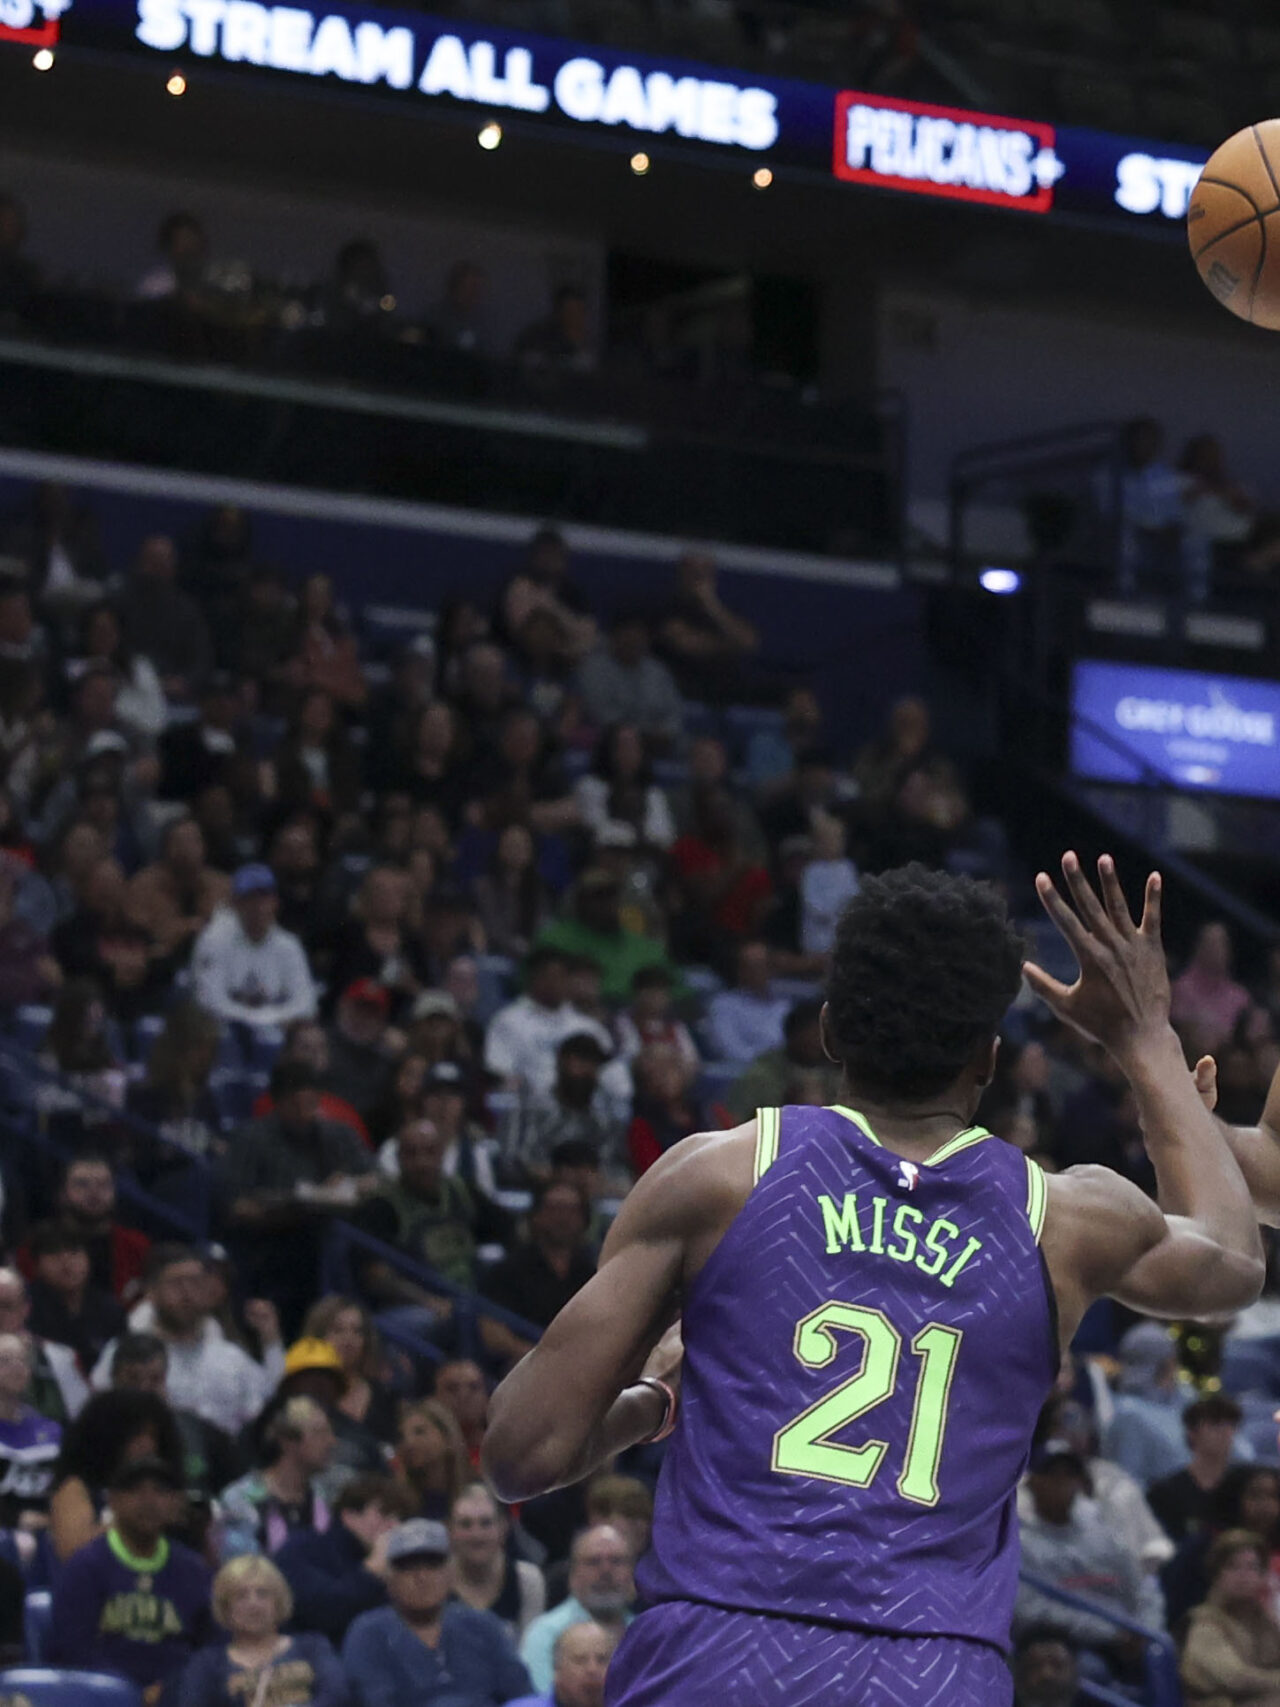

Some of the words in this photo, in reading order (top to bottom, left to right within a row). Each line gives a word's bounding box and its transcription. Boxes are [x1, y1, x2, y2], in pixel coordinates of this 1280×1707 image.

[136, 0, 414, 88] STREAM
[419, 36, 549, 111] ALL
[554, 58, 778, 149] GAMES
[817, 1193, 982, 1289] MISSI
[771, 1300, 965, 1508] 21
